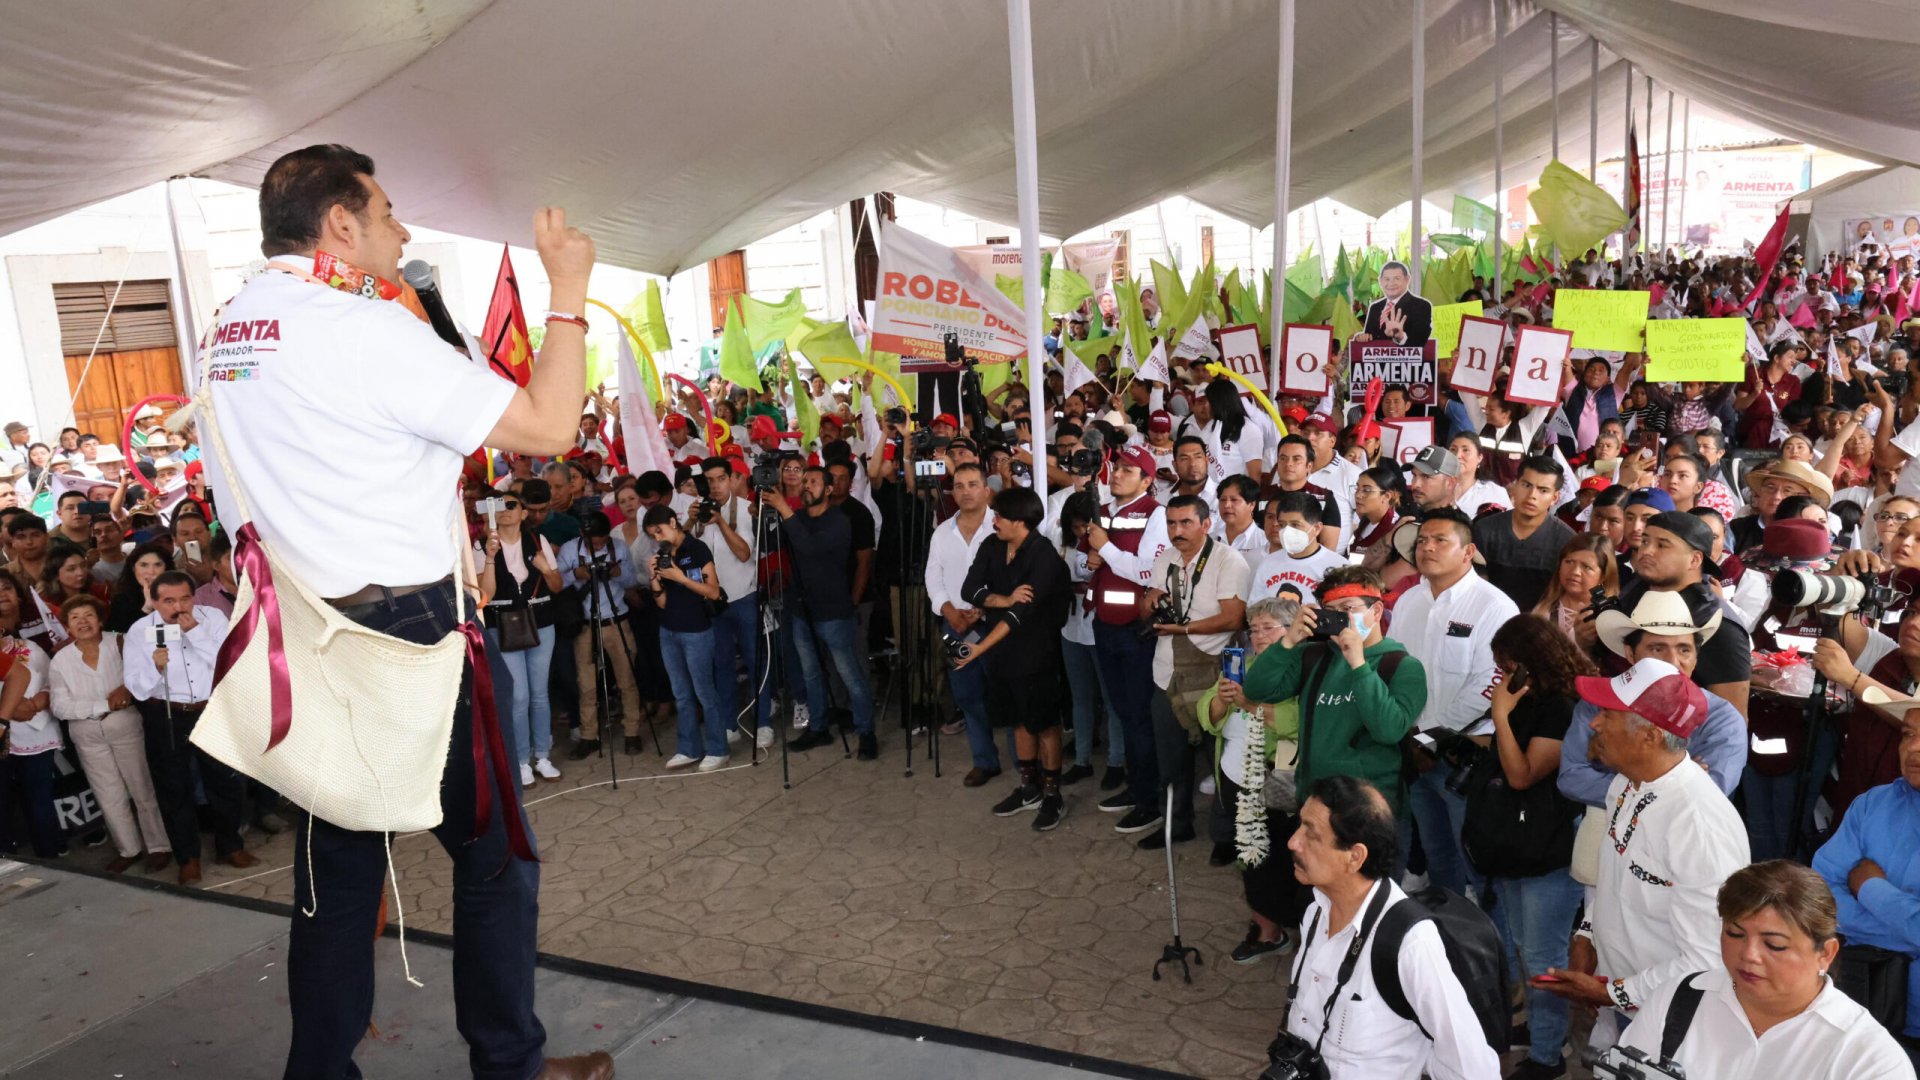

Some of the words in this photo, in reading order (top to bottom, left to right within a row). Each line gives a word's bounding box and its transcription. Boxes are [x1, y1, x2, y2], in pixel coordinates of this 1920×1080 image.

[1723, 181, 1795, 192] ARMENTA
[881, 298, 981, 325] PONCIANO
[933, 322, 995, 341] PRESIDENTE
[1364, 348, 1421, 357] ARMENTA
[1227, 353, 1262, 376] m
[1295, 352, 1318, 373] o
[1352, 362, 1433, 383] ARMENTA
[1464, 346, 1487, 371] n
[1527, 356, 1550, 382] a
